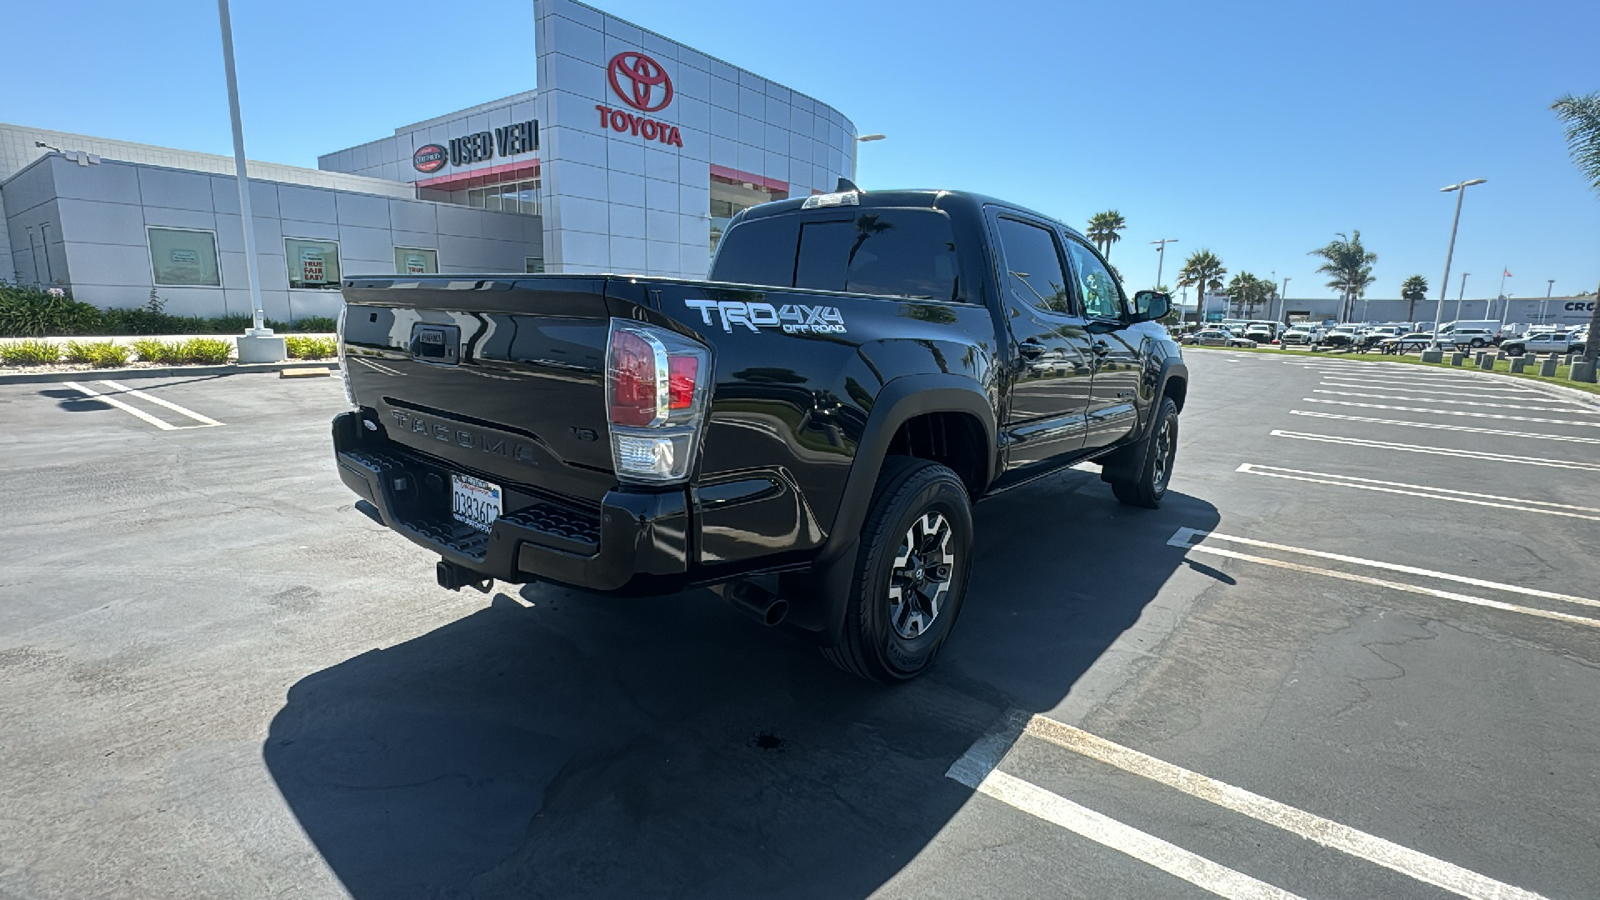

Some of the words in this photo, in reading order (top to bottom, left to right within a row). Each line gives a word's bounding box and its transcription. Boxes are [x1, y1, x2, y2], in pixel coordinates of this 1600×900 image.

[596, 105, 683, 147] TOYOTA
[449, 131, 493, 167] USED
[684, 299, 781, 334] TRD
[779, 304, 845, 325] 4X4
[782, 324, 811, 333] OFF
[812, 324, 847, 334] ROAD
[390, 409, 539, 466] TACOMA
